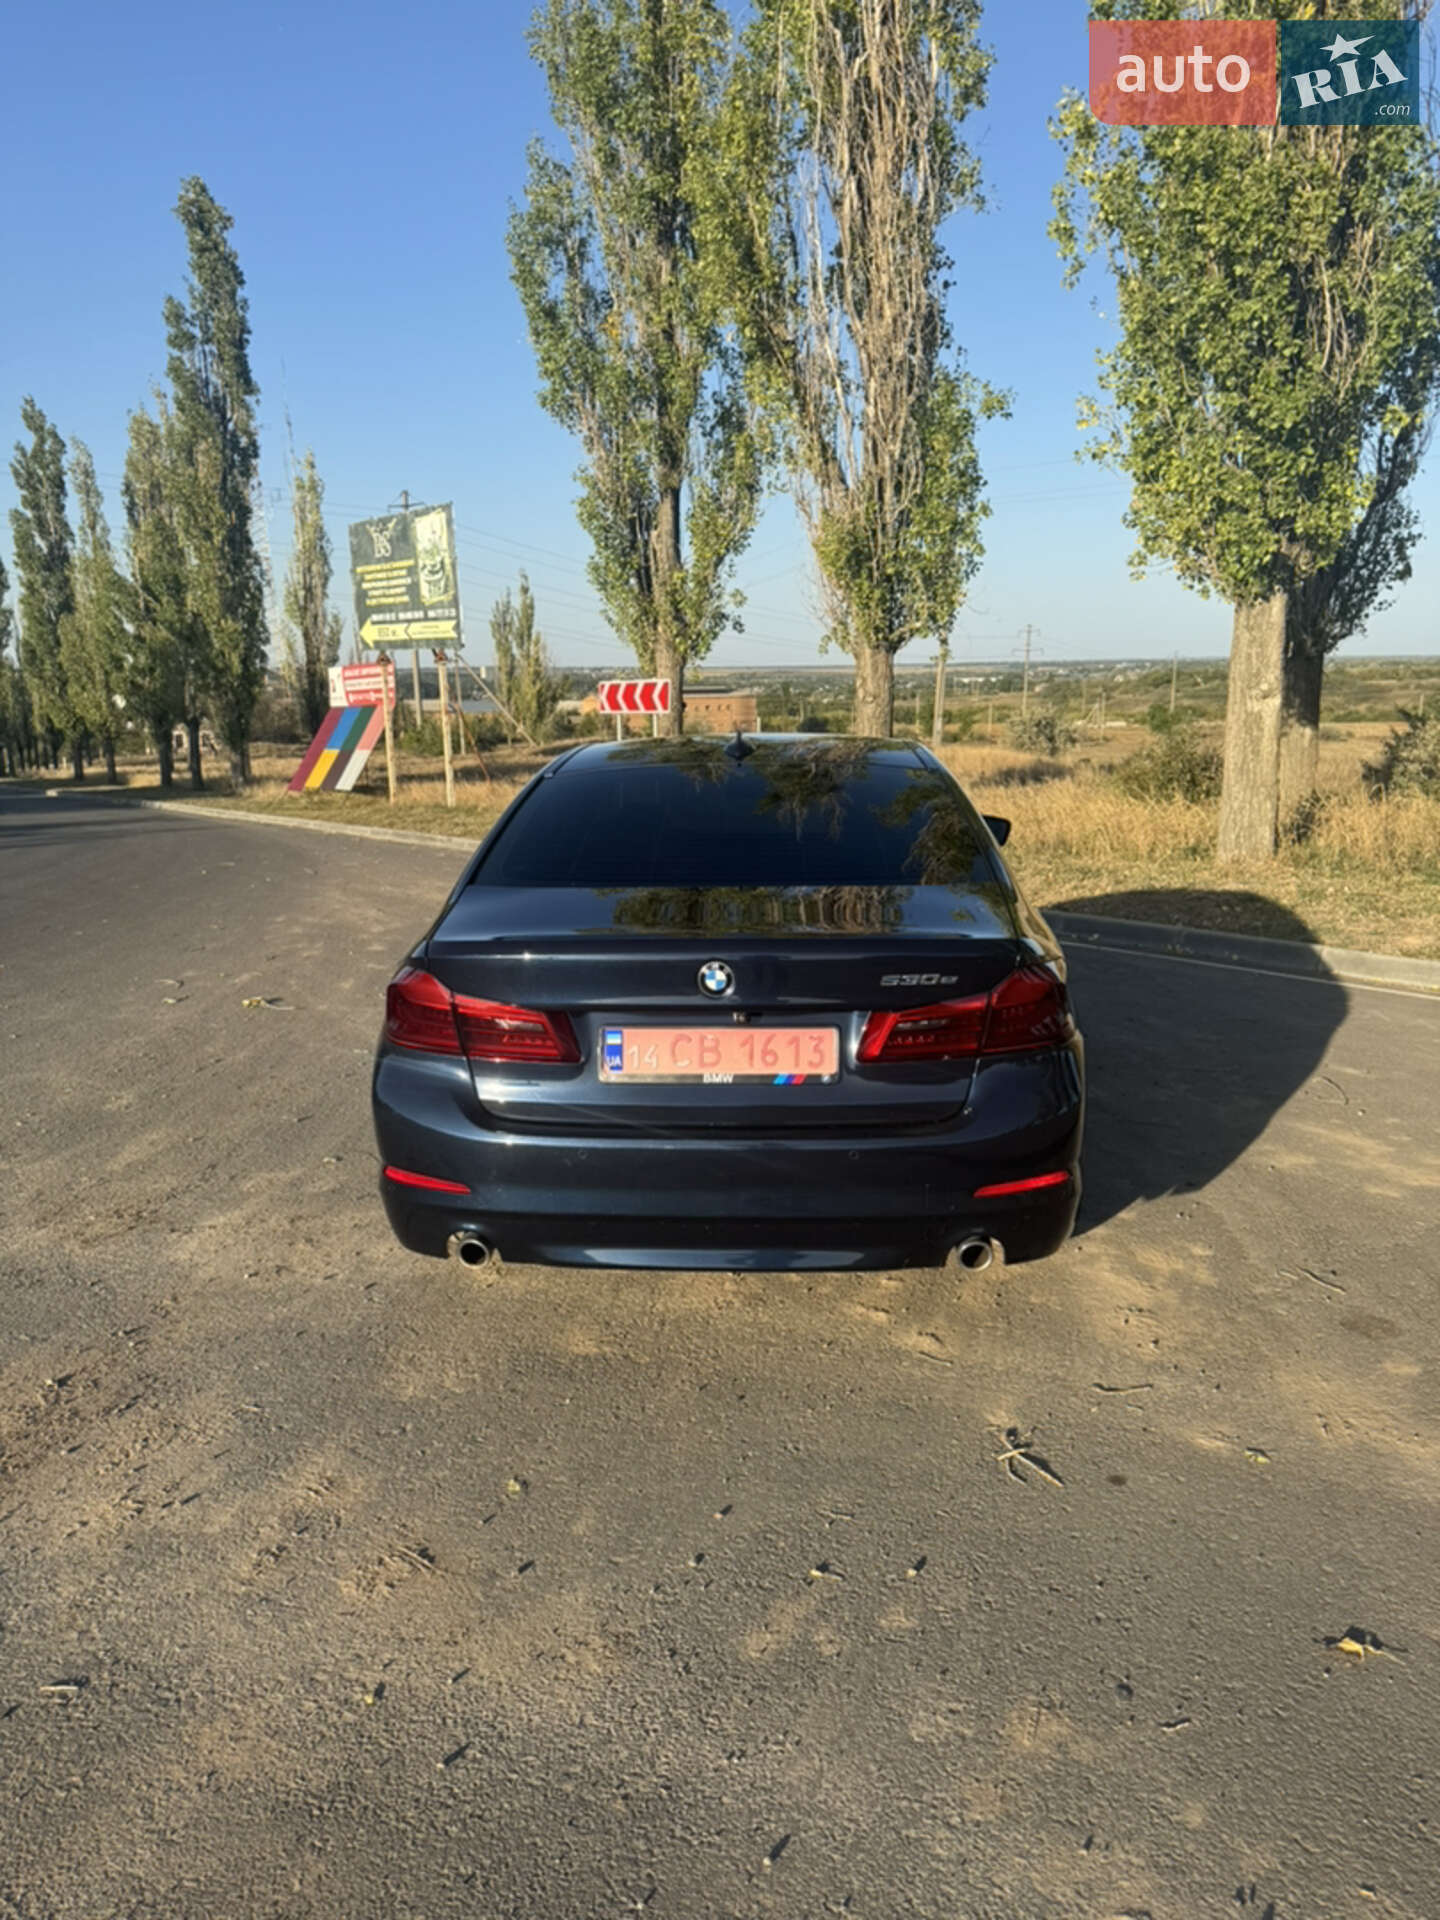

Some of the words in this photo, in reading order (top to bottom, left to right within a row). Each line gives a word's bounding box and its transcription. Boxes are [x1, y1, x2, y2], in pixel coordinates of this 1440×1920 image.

[629, 1044, 657, 1069] 14
[739, 1033, 825, 1069] 1613
[607, 1056, 621, 1066] UA
[703, 1073, 734, 1083] BMW
